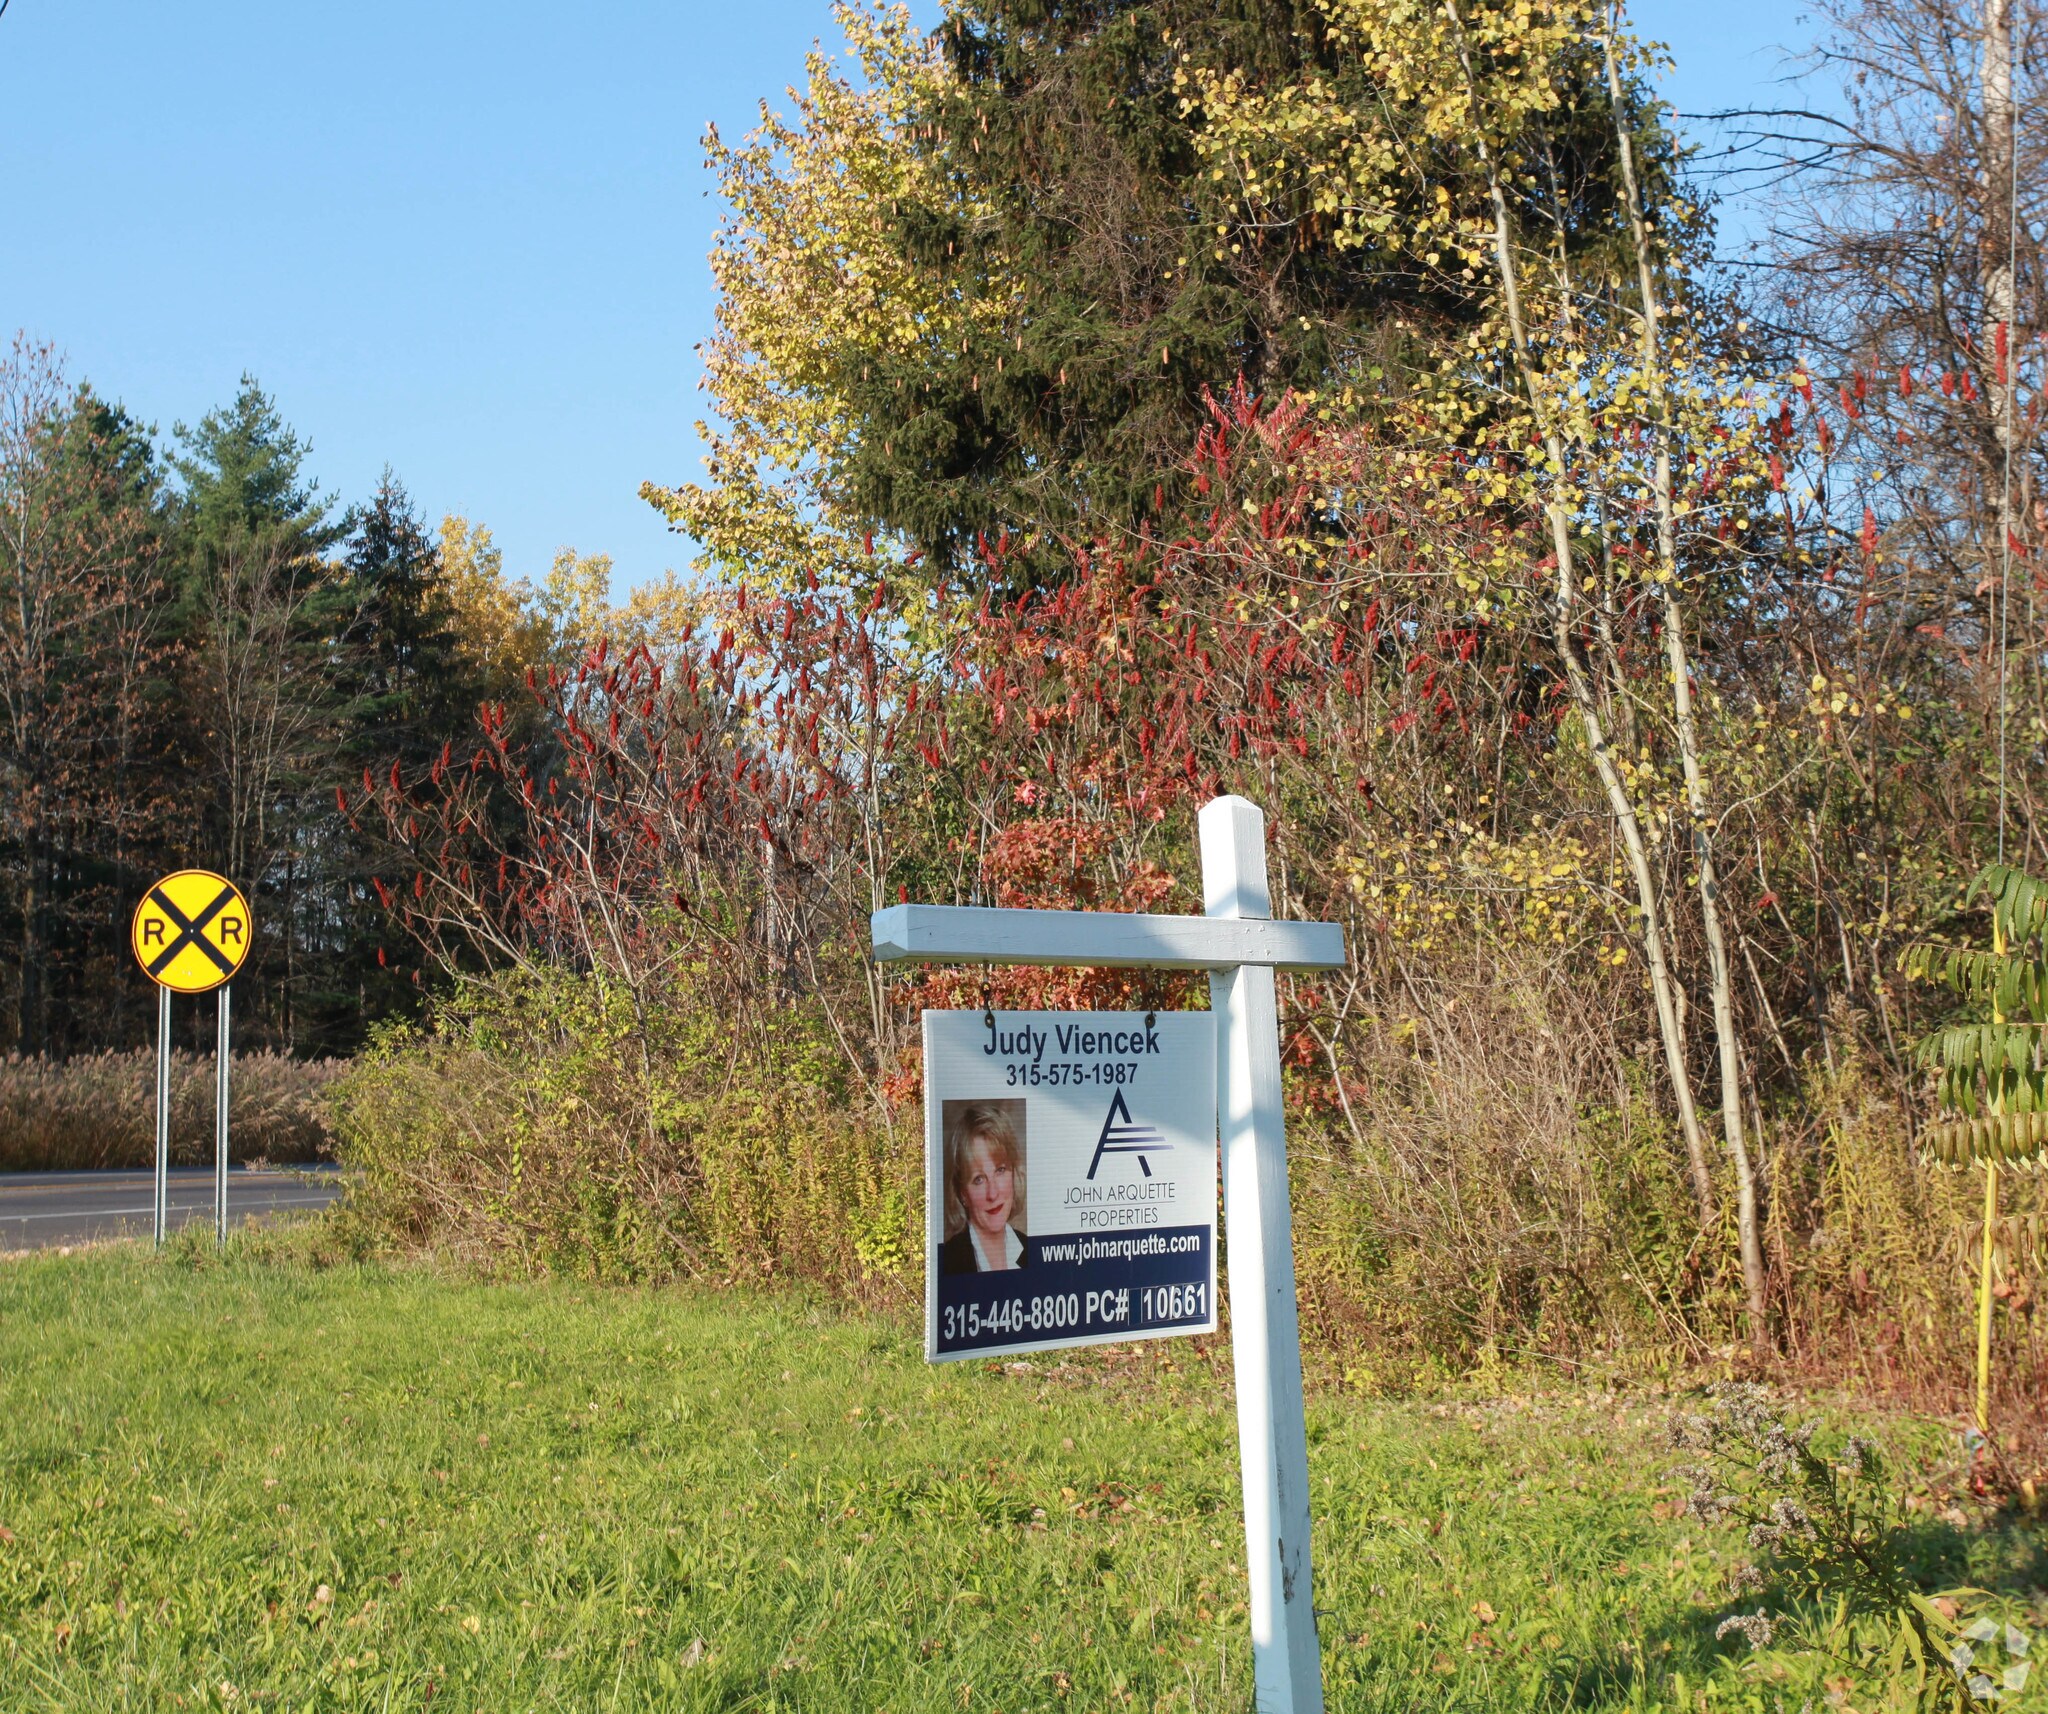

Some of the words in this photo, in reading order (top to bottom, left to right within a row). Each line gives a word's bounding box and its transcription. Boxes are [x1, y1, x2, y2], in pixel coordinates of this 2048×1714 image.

[143, 918, 166, 946] R
[220, 916, 243, 945] R
[983, 1023, 1048, 1063] Judy
[1055, 1023, 1161, 1055] Viencek
[1006, 1063, 1138, 1086] 315-575-1987
[1063, 1186, 1102, 1204] JOHN
[1107, 1182, 1176, 1201] ARQUETTE
[1080, 1207, 1159, 1228] PROPERTIES
[1041, 1234, 1200, 1266] www.johnarquette.com
[944, 1293, 1079, 1340] 315-446-8800
[1085, 1288, 1129, 1324] PC#
